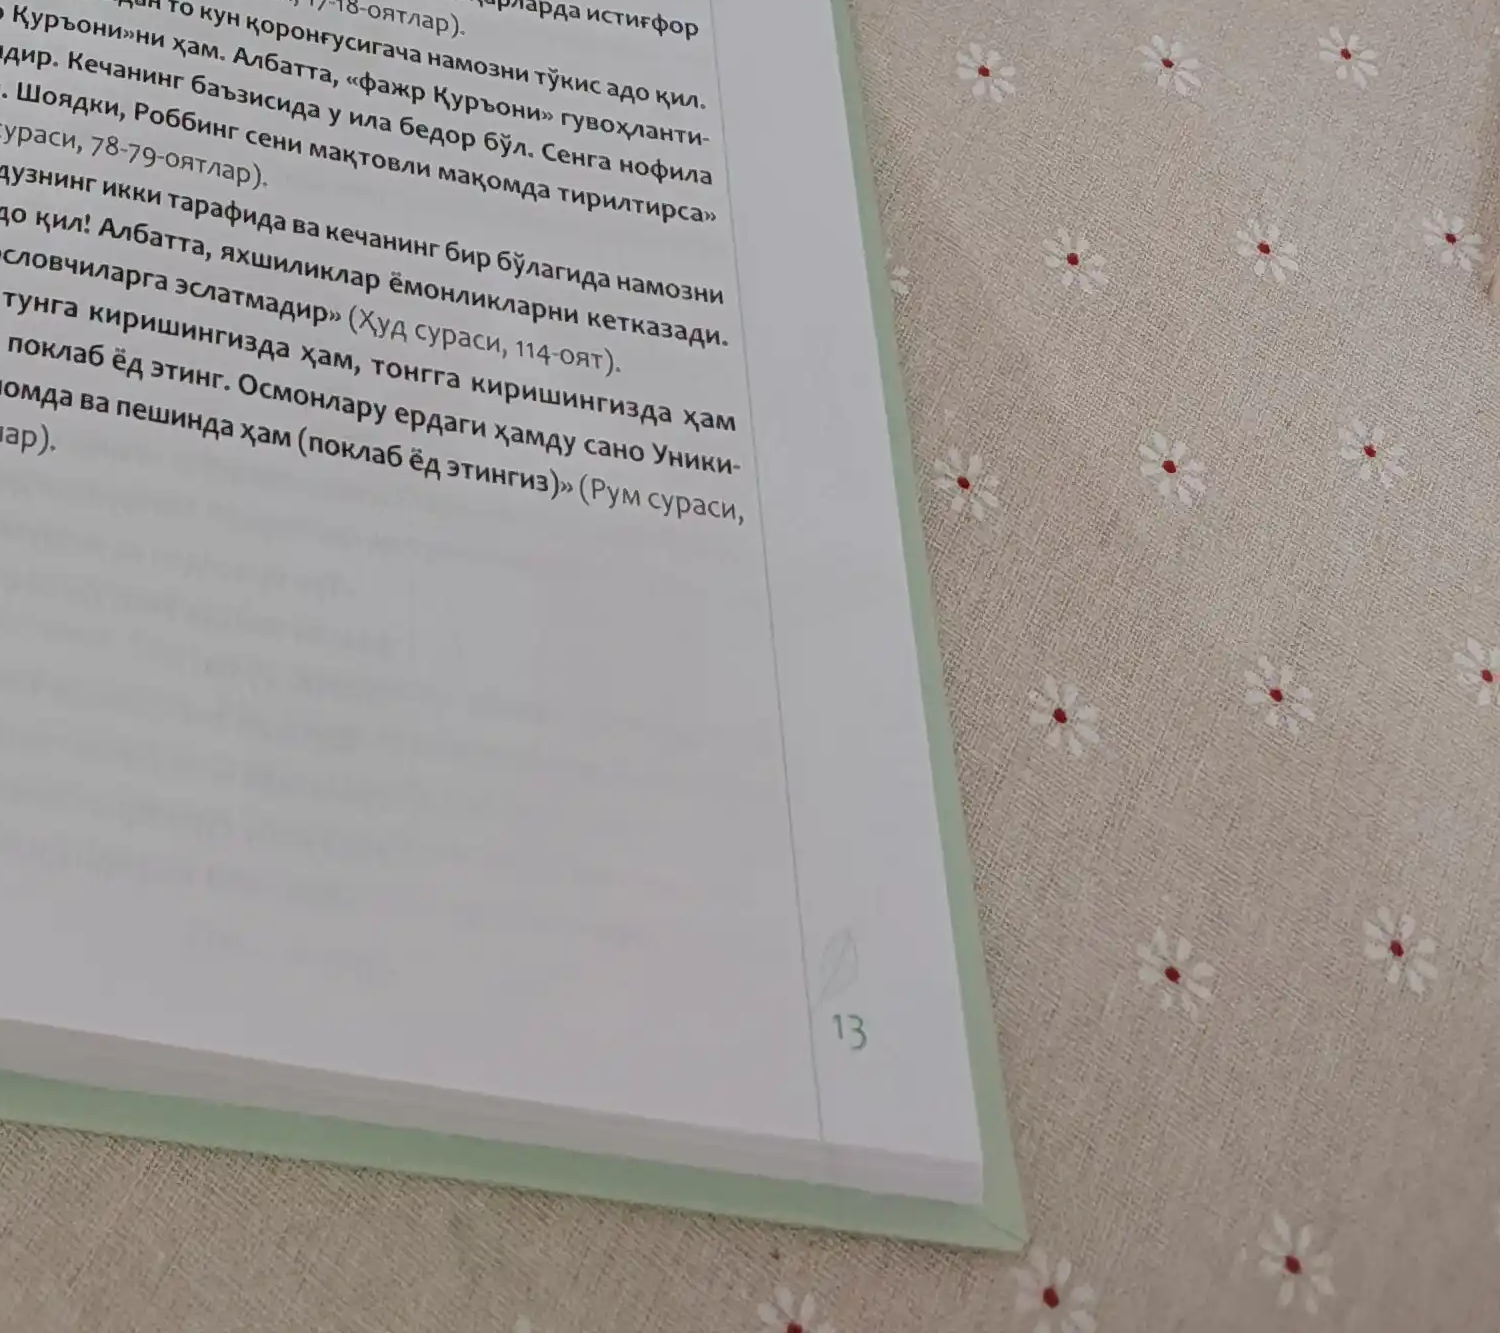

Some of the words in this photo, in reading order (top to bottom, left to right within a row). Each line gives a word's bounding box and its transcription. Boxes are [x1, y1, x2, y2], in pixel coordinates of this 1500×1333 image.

[2, 292, 78, 318] тунга
[89, 305, 289, 361] киришингизда
[371, 359, 460, 389] тонгга
[472, 377, 672, 426] киришингизда
[683, 409, 736, 432] ҳам
[349, 305, 407, 342] (Ҳуд
[415, 324, 507, 359] сураси,
[516, 340, 621, 377] 114-оят).
[833, 1014, 867, 1051] 13
